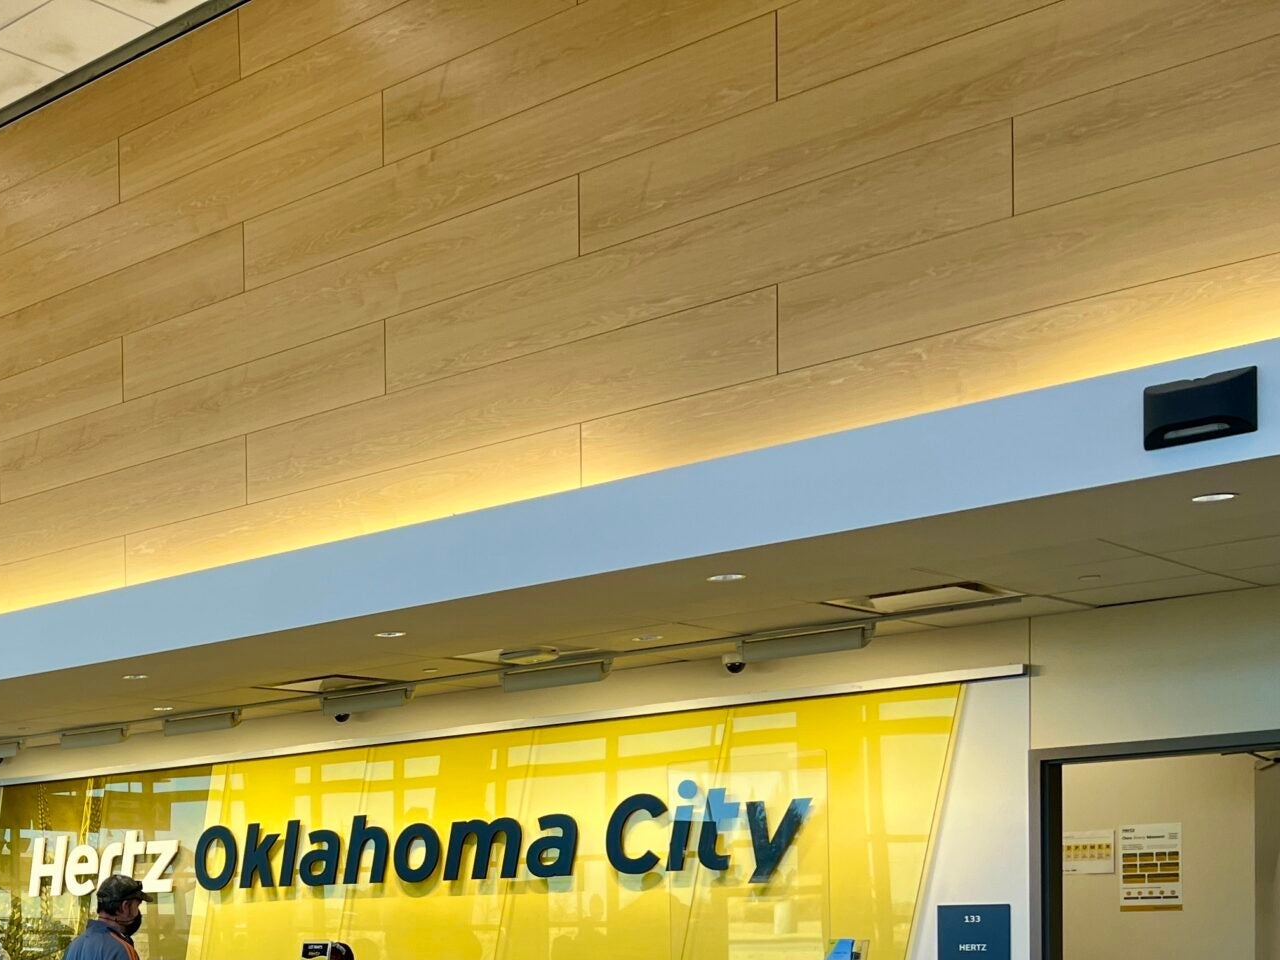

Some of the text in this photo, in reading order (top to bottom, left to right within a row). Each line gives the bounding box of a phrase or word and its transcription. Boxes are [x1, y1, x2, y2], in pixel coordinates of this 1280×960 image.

[28, 779, 813, 897] Hertz Oklahoma City
[964, 915, 981, 923] 133
[959, 943, 987, 952] HERTZ
